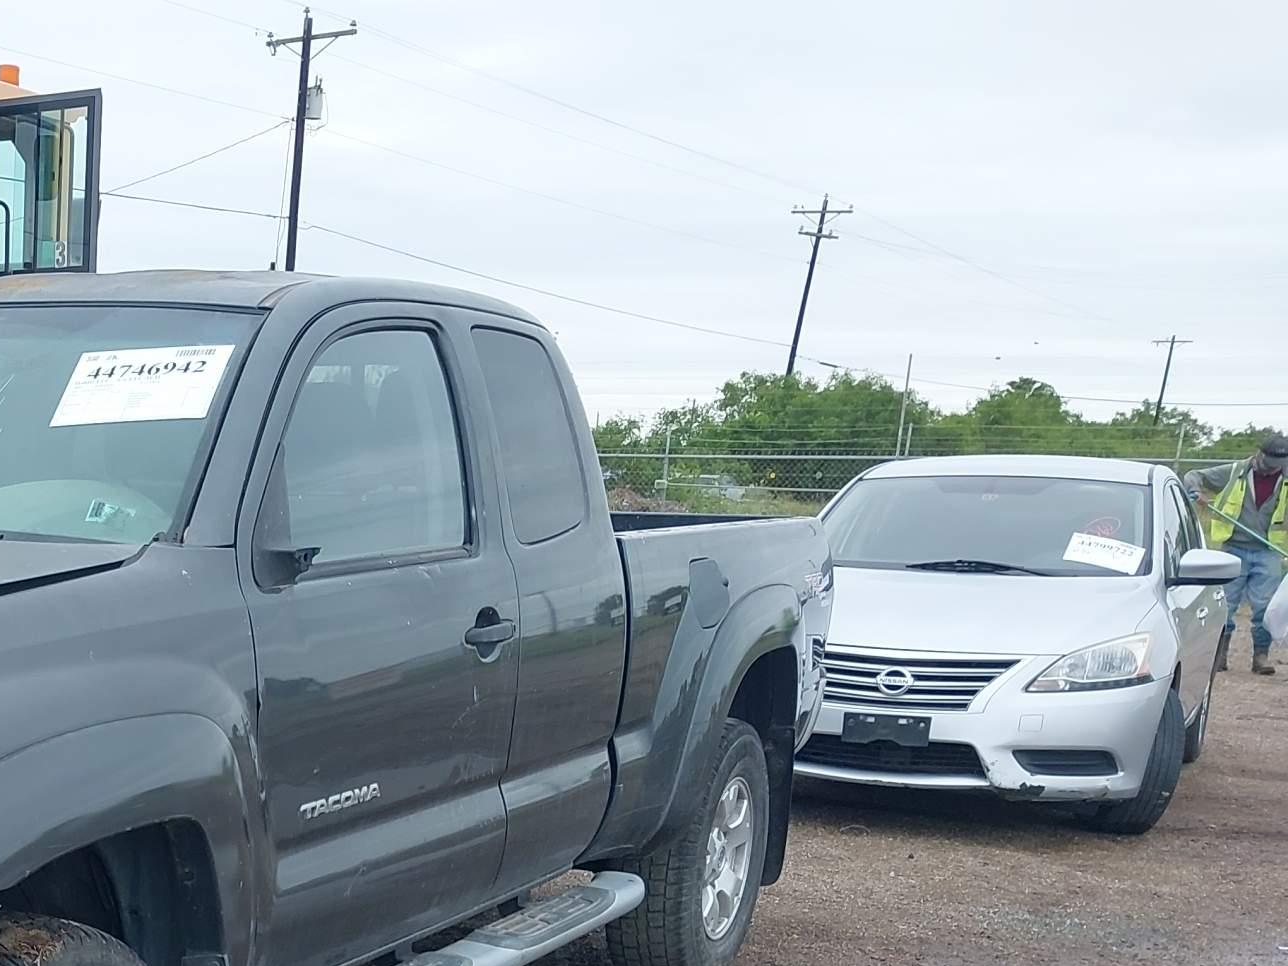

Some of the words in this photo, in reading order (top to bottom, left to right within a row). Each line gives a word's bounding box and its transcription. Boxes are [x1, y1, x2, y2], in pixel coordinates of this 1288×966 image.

[55, 240, 66, 267] 3
[87, 360, 207, 379] 44746942
[299, 782, 381, 819] TACOMA
